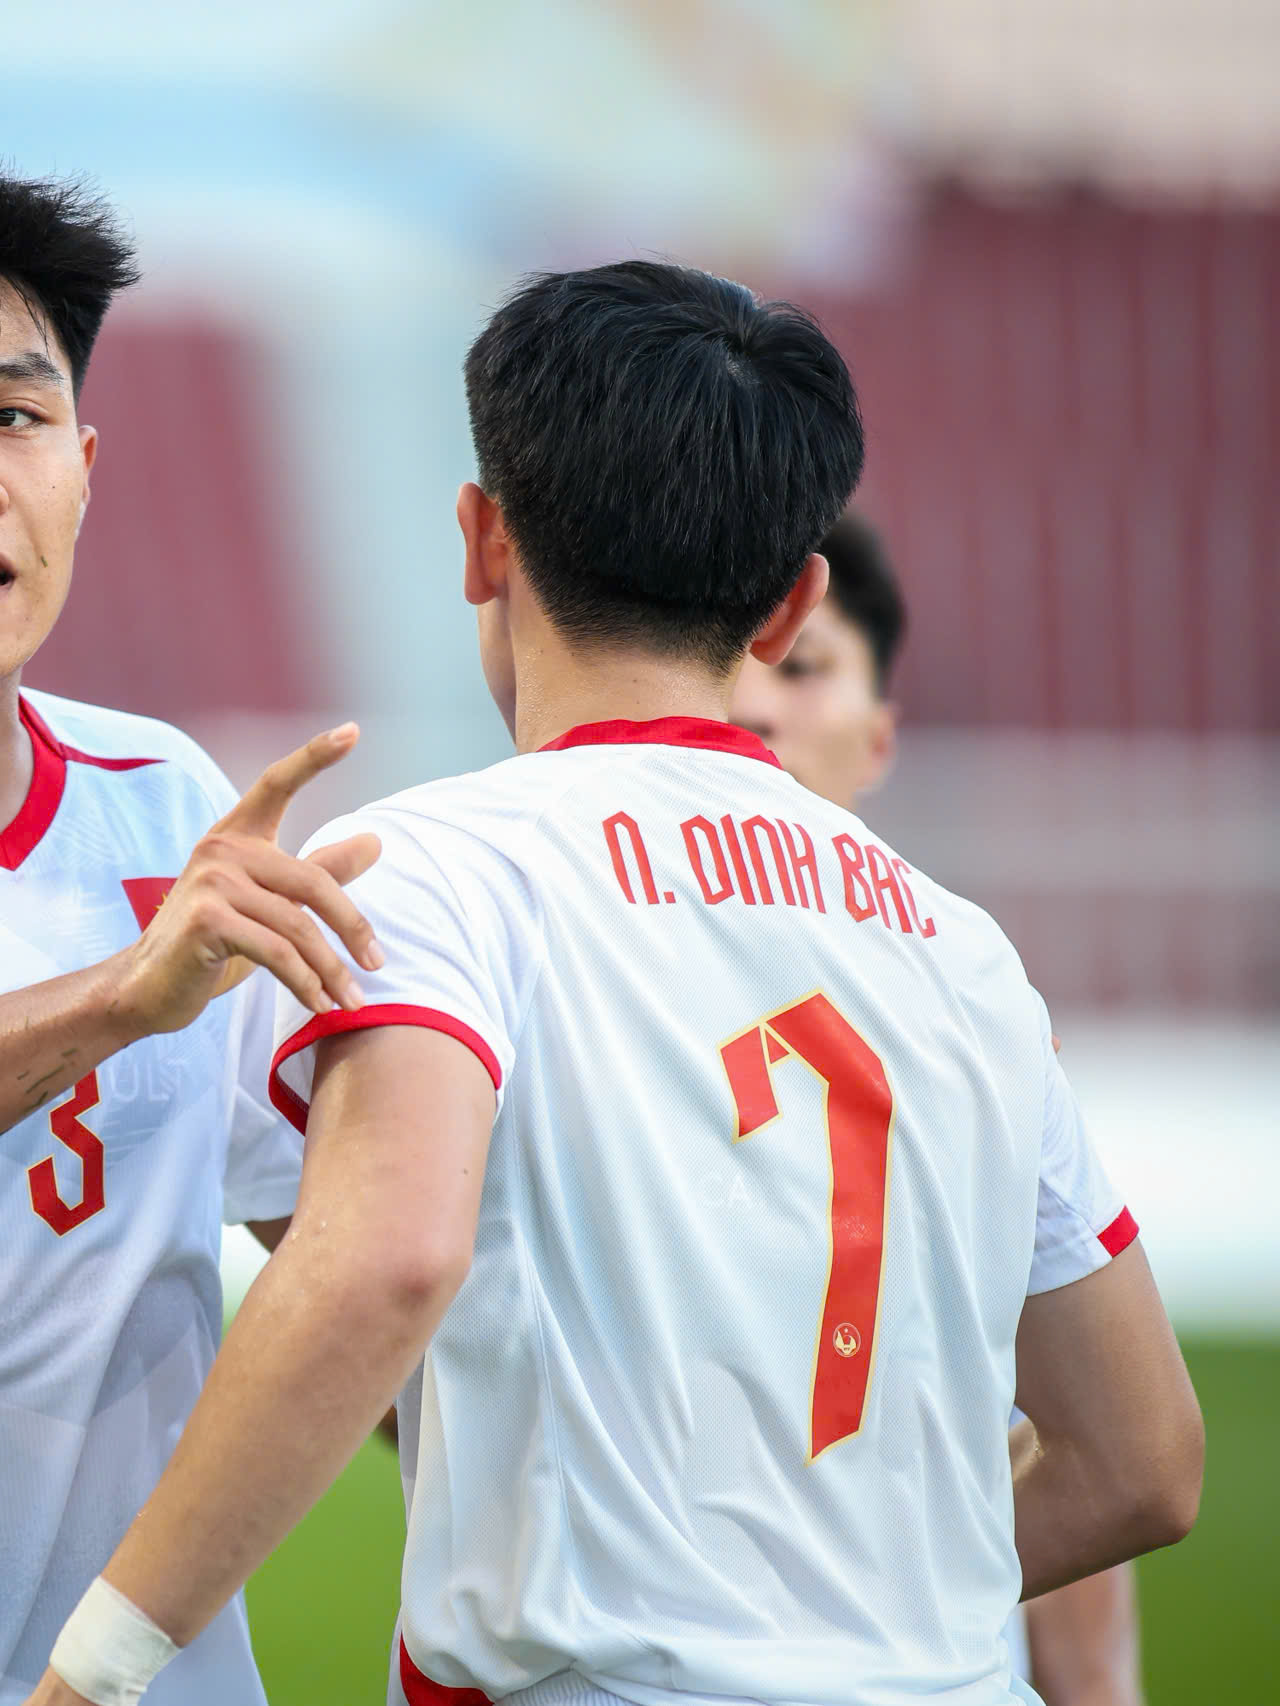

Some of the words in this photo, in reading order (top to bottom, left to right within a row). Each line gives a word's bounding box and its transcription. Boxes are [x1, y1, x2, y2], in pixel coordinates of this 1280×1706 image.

[679, 813, 827, 914] DINH
[831, 832, 937, 939] BAC
[26, 1068, 106, 1238] 3
[718, 990, 895, 1463] 7
